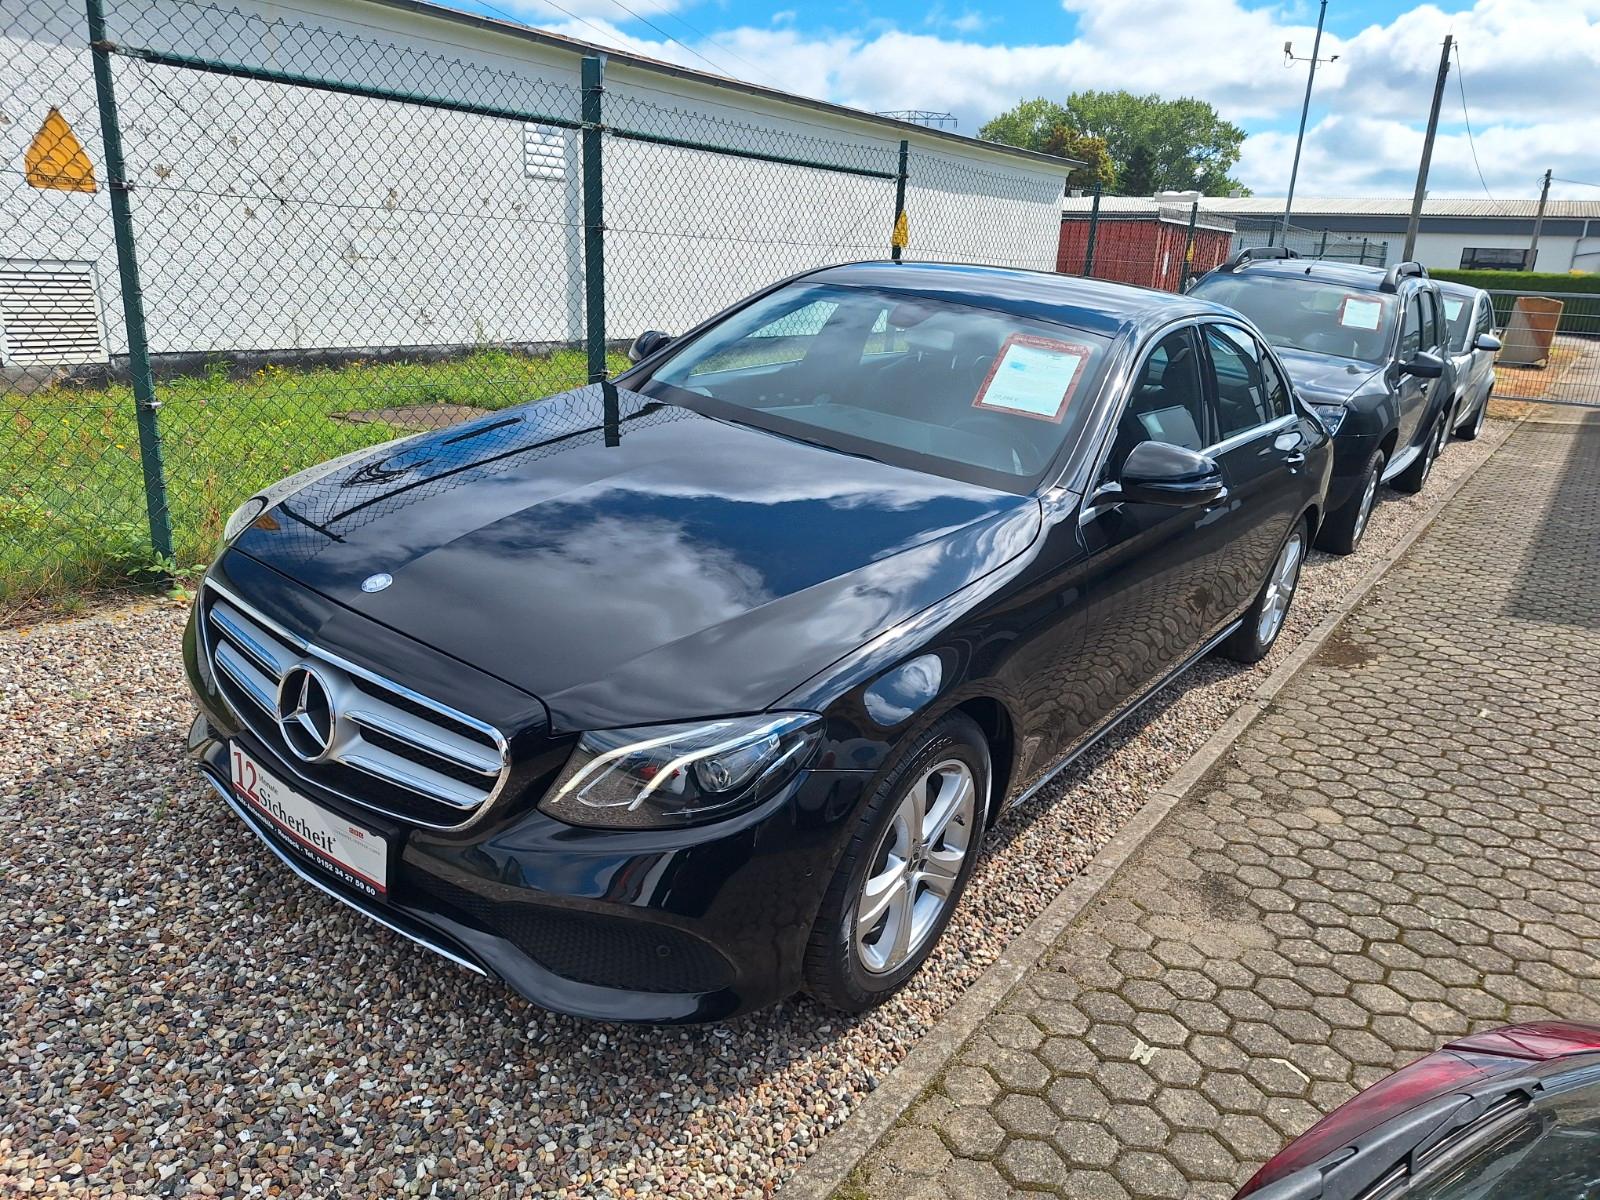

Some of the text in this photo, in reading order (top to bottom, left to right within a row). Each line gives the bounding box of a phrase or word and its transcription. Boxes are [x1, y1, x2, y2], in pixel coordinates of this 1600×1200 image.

[234, 752, 259, 802] 12
[304, 848, 316, 860] Tel.
[316, 856, 334, 872] 0152
[344, 873, 354, 884] 27
